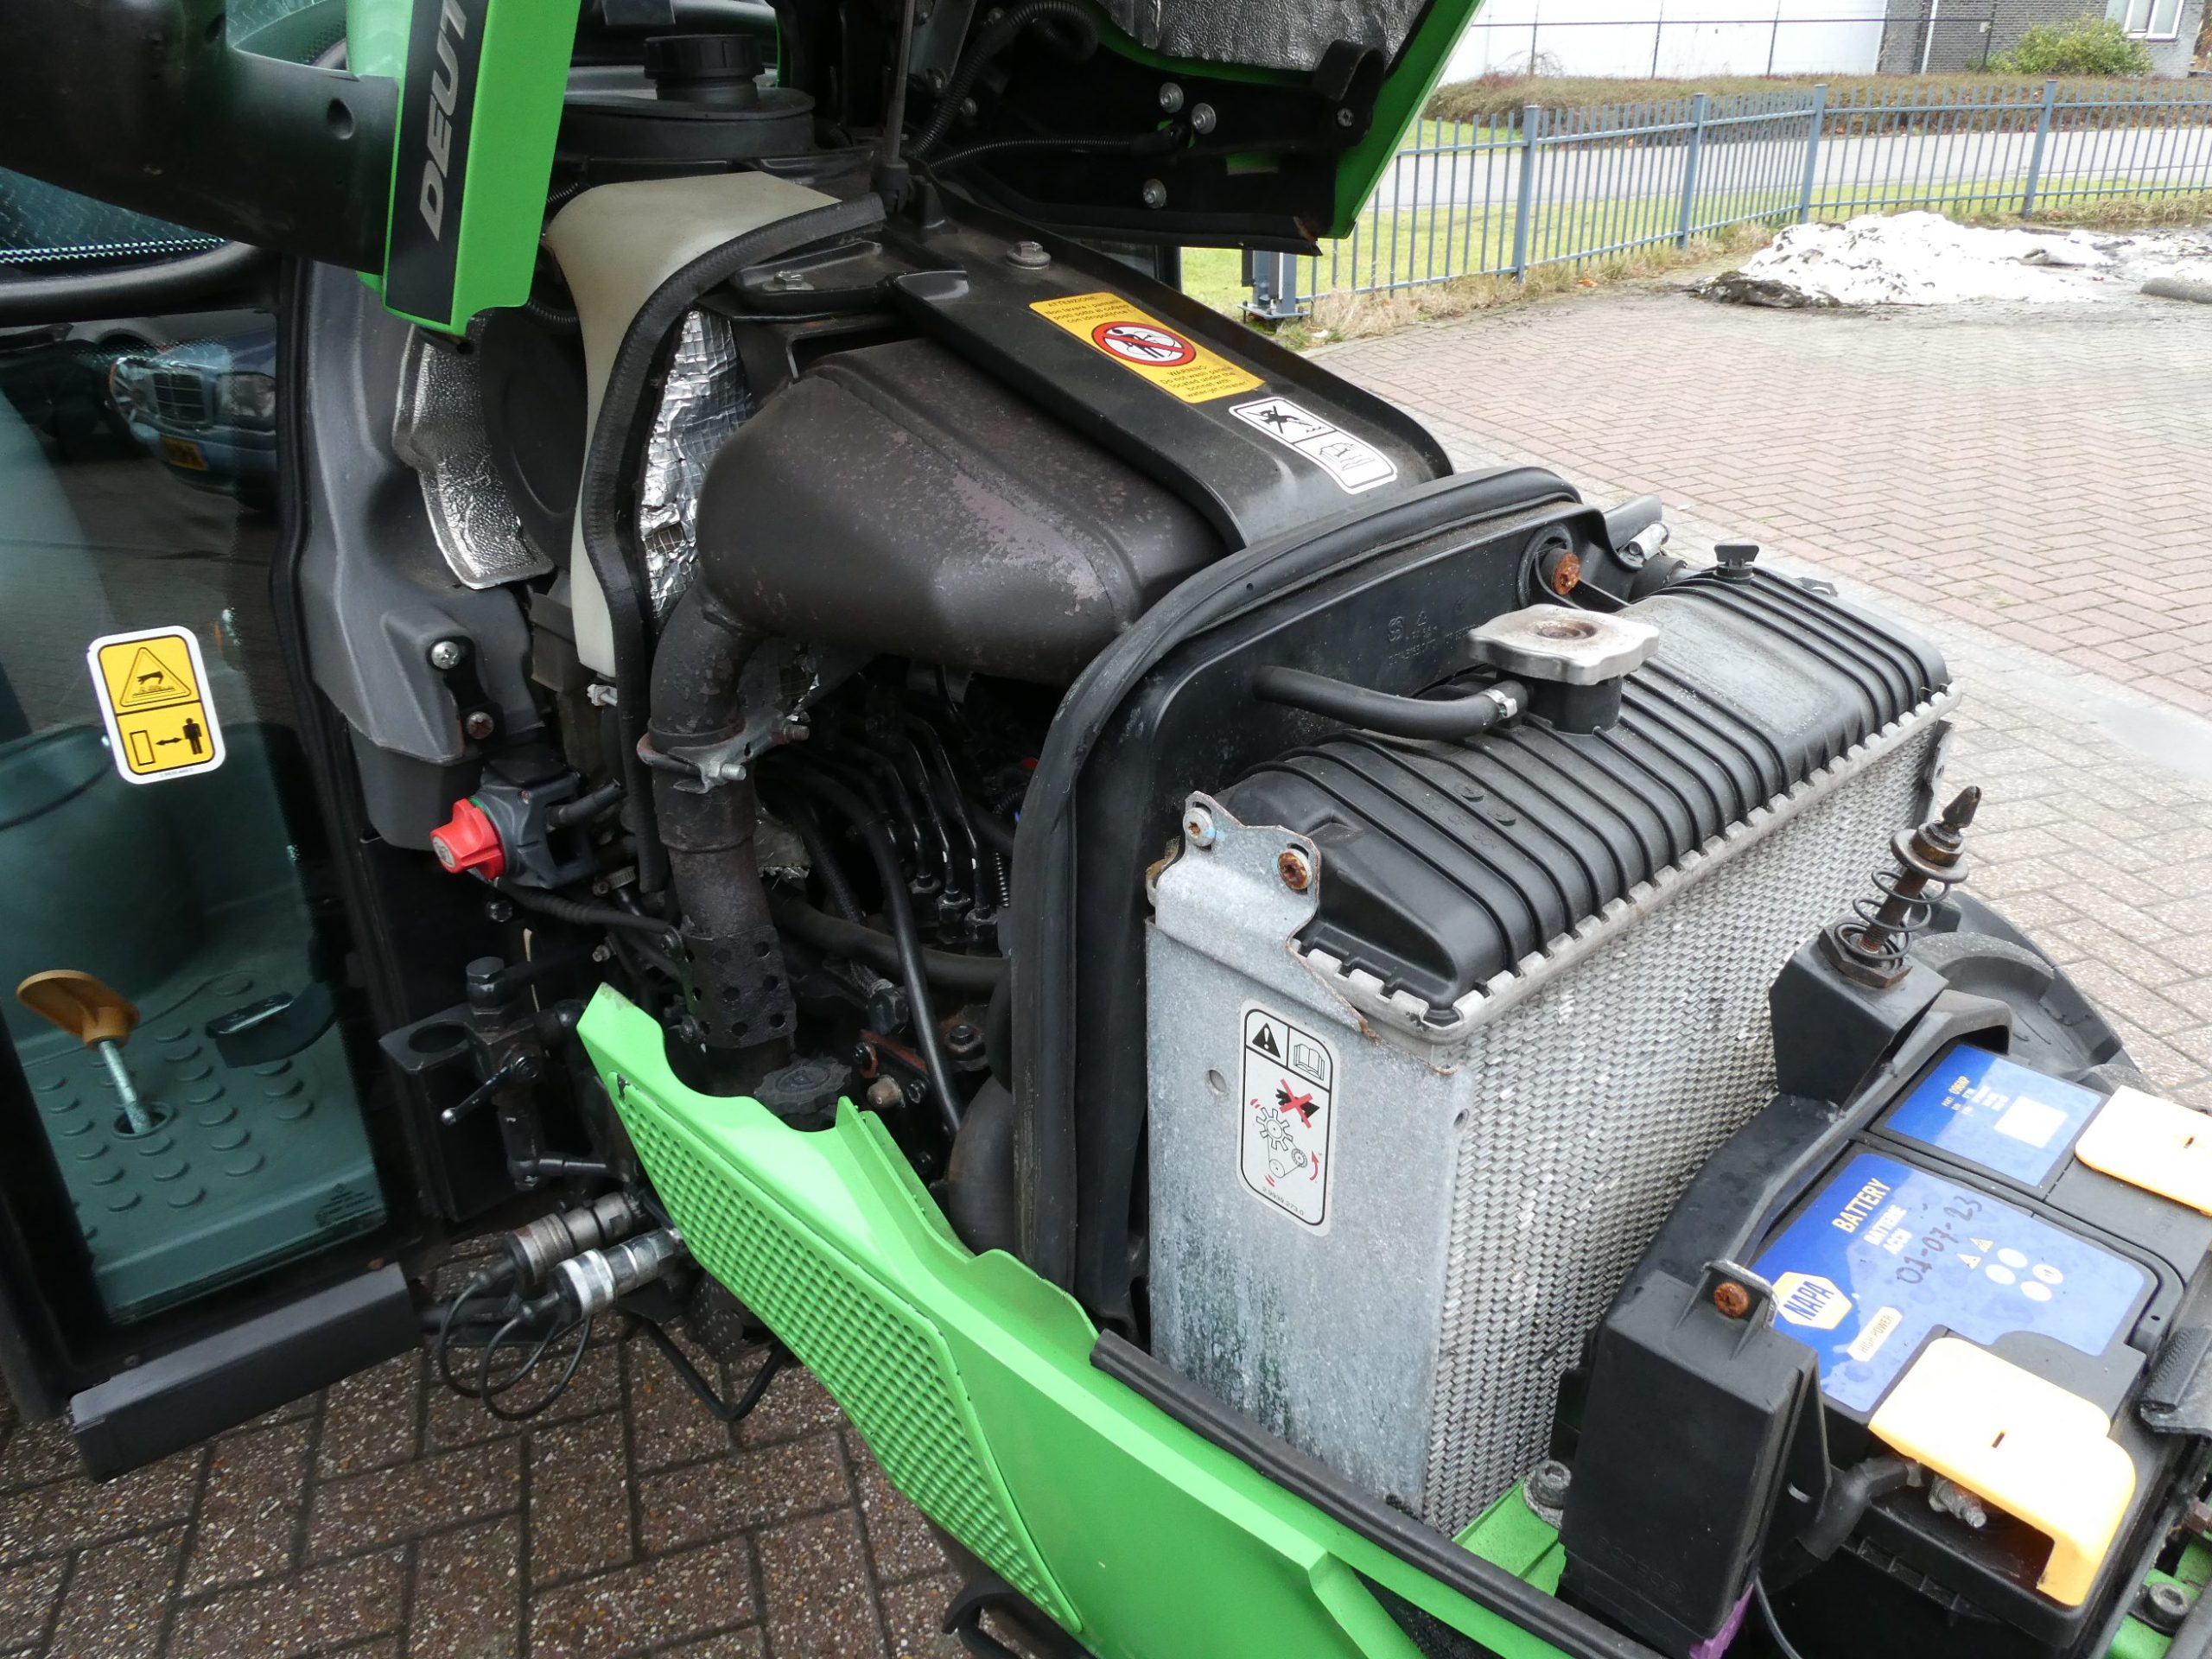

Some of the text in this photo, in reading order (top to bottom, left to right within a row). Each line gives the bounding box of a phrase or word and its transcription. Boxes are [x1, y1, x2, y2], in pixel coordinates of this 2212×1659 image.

[1832, 1178, 1891, 1234] BATTERY
[1783, 1281, 1834, 1320] NAPA
[1873, 1314, 1894, 1337] POWER
